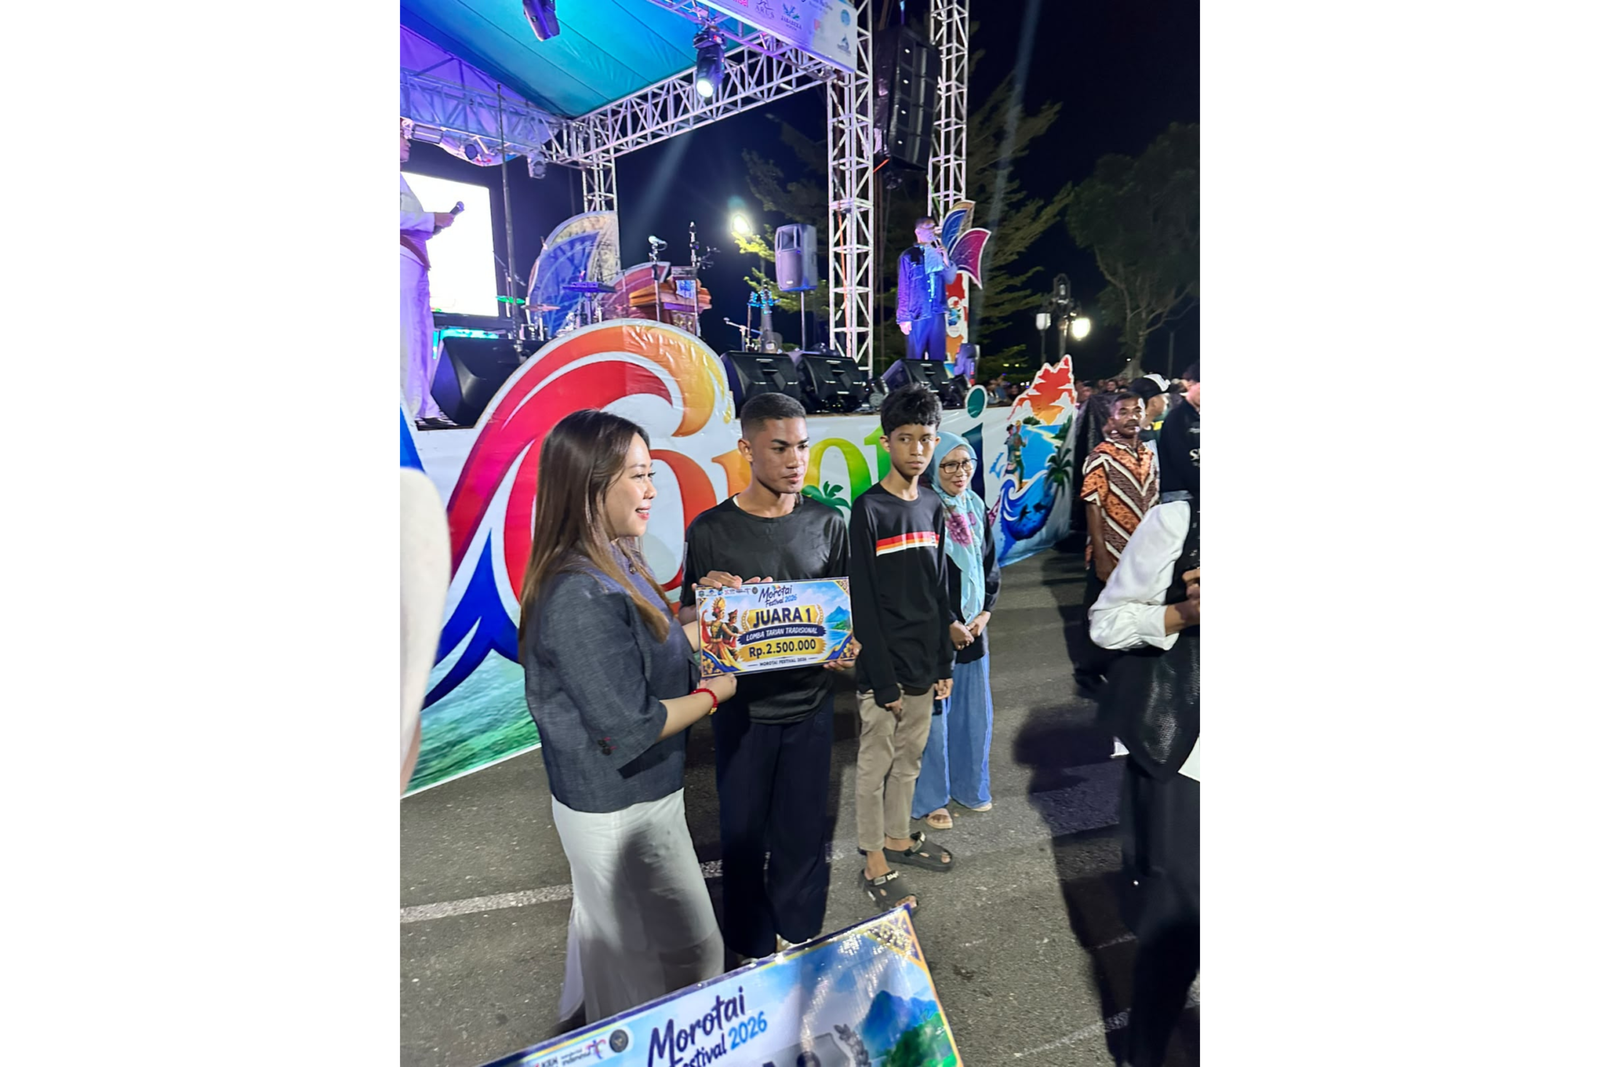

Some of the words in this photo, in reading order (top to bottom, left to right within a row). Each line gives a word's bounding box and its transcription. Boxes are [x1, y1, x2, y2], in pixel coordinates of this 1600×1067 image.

[753, 607, 803, 628] JUARA
[805, 607, 812, 622] 1
[746, 631, 764, 641] LOMBA
[766, 627, 785, 637] TARIAN
[785, 626, 818, 634] TRADISIONAL
[749, 639, 816, 659] Rp.2.500.000
[648, 986, 746, 1067] Morotai
[728, 1011, 768, 1050] 2026
